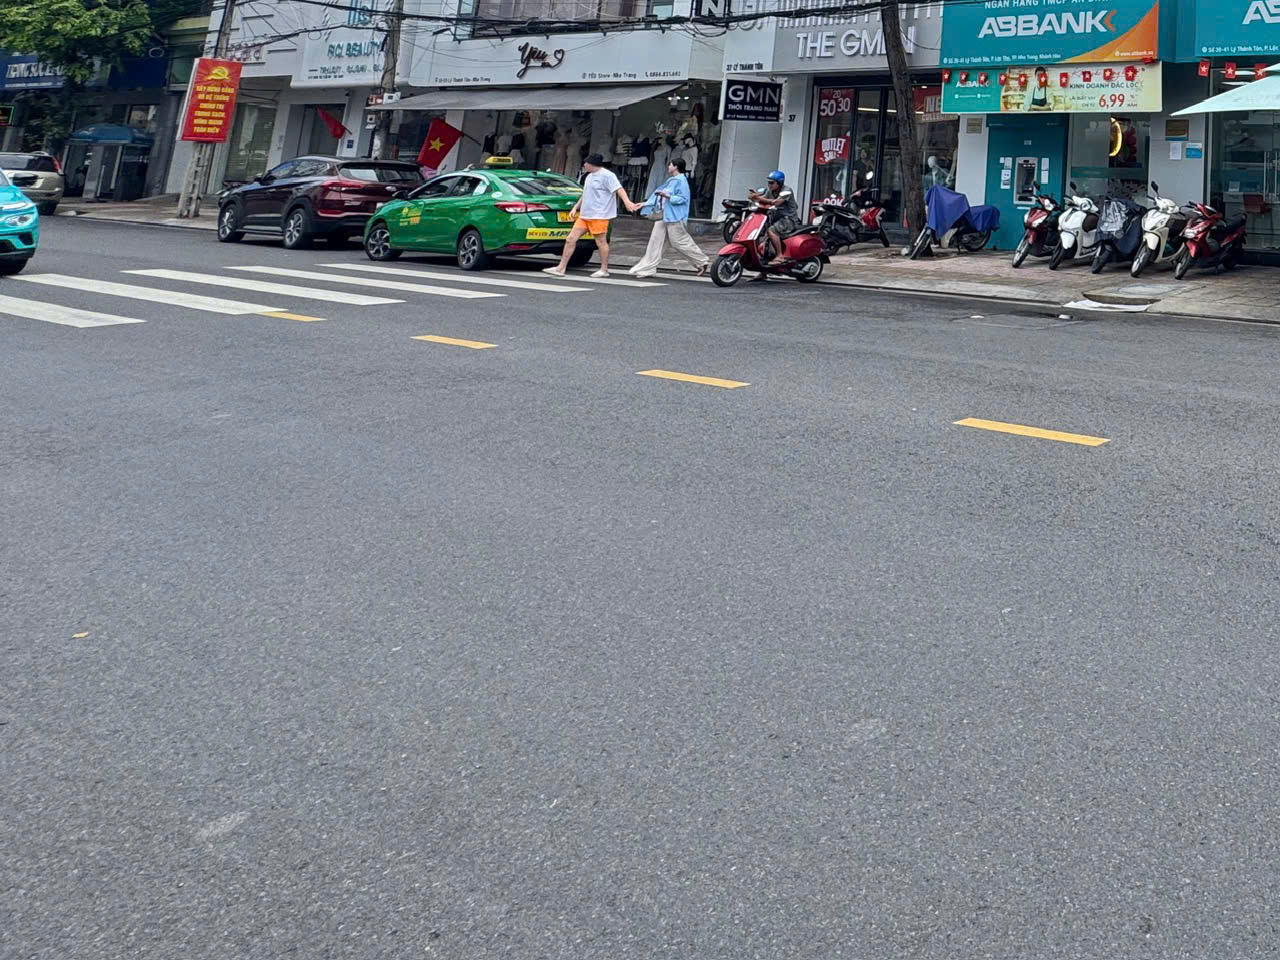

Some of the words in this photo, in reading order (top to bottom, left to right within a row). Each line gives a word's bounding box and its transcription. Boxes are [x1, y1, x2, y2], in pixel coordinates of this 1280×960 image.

[977, 9, 1109, 39] ABBANK
[796, 31, 836, 58] THE
[840, 25, 916, 56] GMN
[728, 84, 780, 105] GMN
[833, 89, 842, 99] 20
[1099, 93, 1126, 109] 6,99
[819, 100, 837, 117] 50
[837, 97, 851, 112] 30
[925, 96, 940, 113] NE
[821, 137, 847, 154] OUTLET
